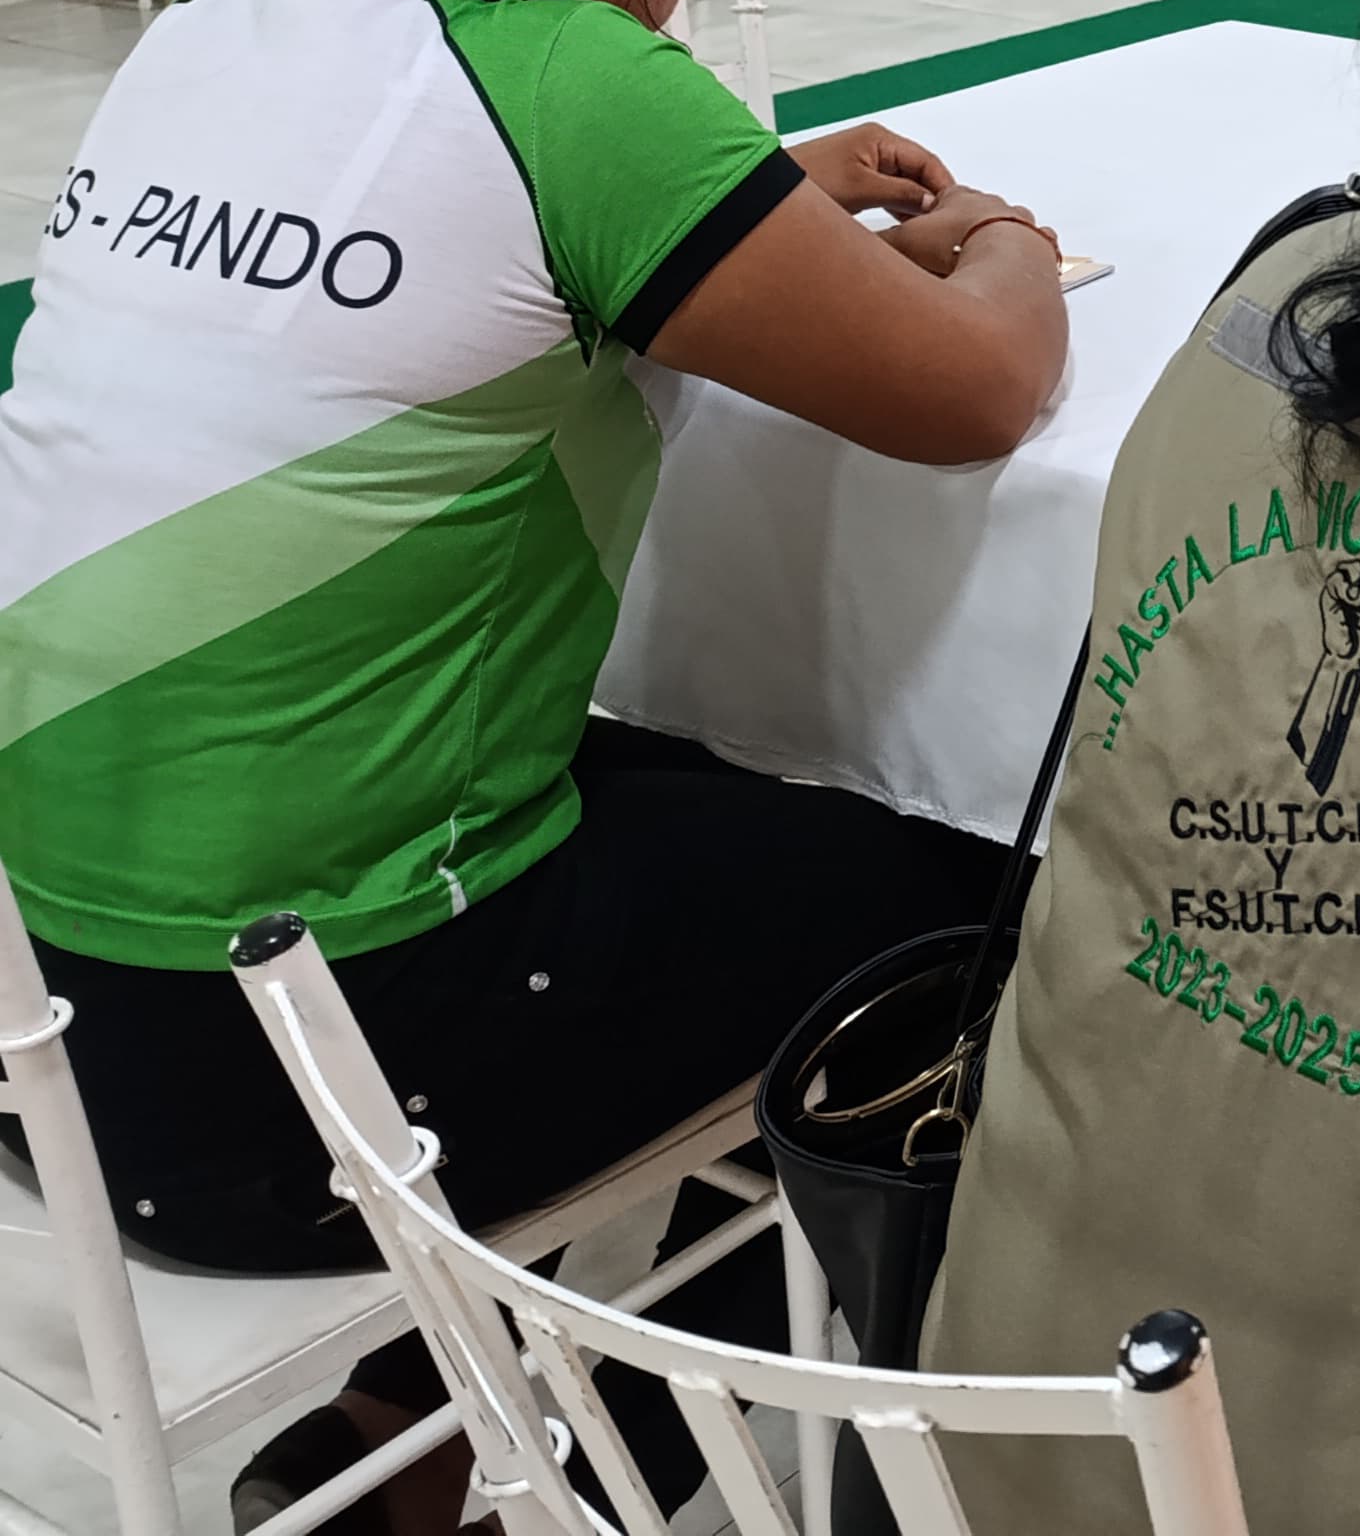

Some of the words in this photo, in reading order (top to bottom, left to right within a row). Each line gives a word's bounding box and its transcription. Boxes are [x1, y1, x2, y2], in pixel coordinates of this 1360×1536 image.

[110, 185, 402, 309] PANDO
[1229, 488, 1294, 565] LA
[1265, 848, 1293, 889] Y
